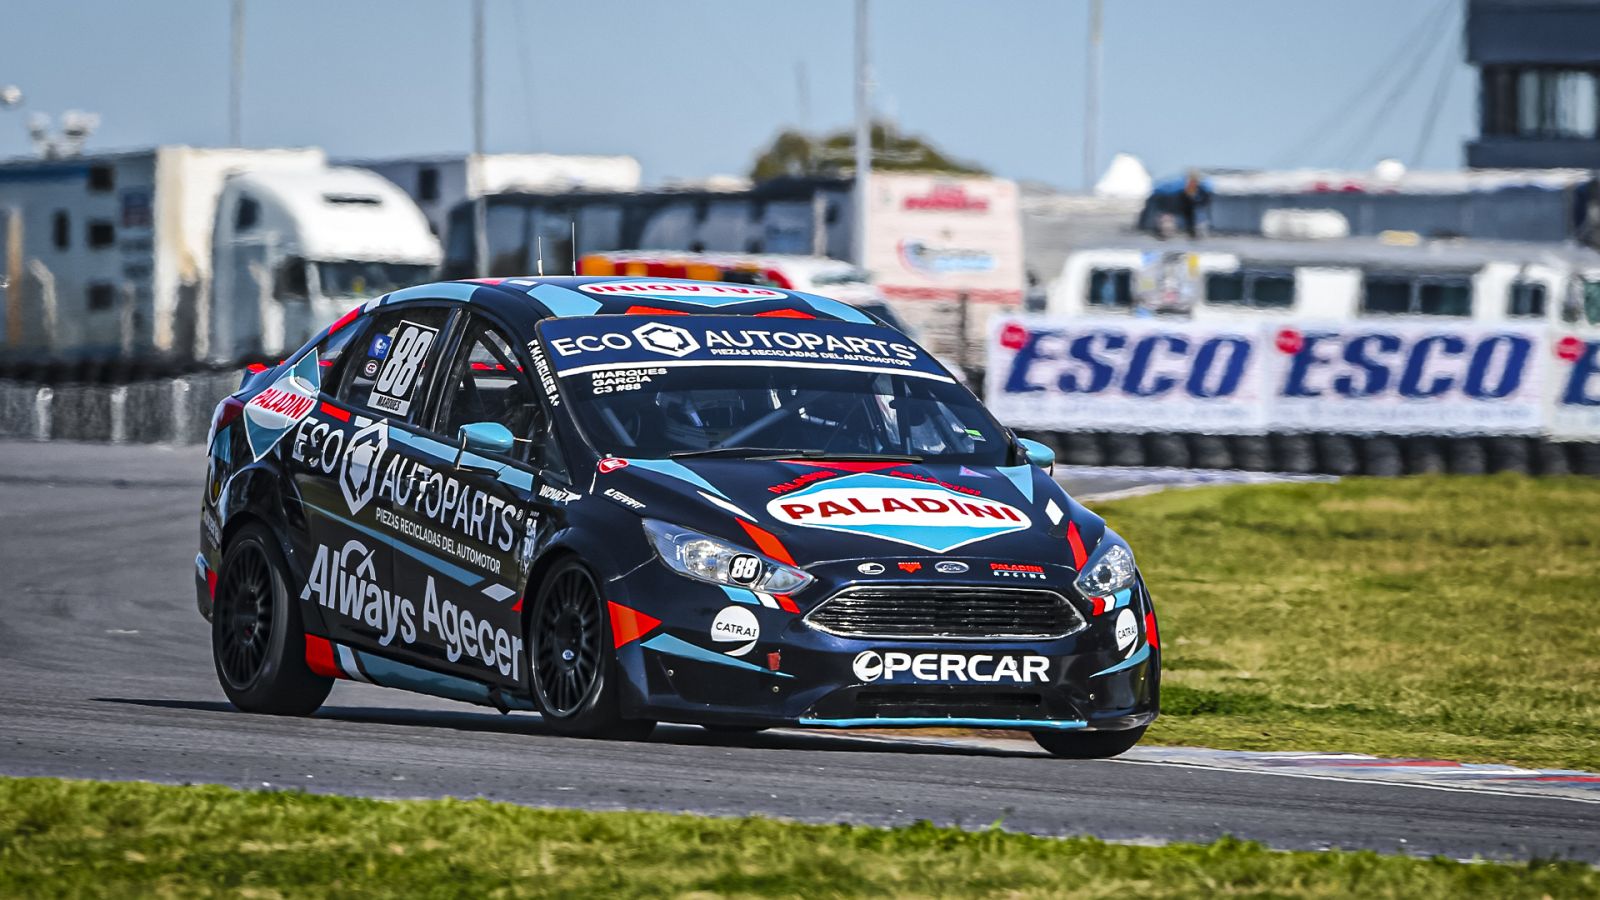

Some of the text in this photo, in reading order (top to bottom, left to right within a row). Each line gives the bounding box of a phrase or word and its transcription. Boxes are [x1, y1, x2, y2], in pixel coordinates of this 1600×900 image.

[550, 332, 633, 357] ECO
[377, 326, 433, 397] 88
[711, 348, 912, 367] PIEZAS RECICLADAS DEL AUTOMOTOR
[1004, 328, 1251, 397] ESCO
[1281, 333, 1532, 398] ESCO
[592, 367, 668, 380] MARQUES
[593, 383, 642, 395] C3 #88
[254, 388, 314, 420] PALADINI
[780, 497, 1021, 523] PALADINI
[376, 506, 400, 530] PIEZAS
[400, 517, 441, 549] RECICLADAS
[442, 535, 456, 555] DEL
[456, 542, 501, 574] AUTOMOTOR
[731, 554, 758, 578] 88
[990, 563, 1044, 573] PALADINI
[993, 571, 1047, 580] RACING
[300, 543, 523, 682] Always Agecer
[715, 621, 757, 638] CATRAI
[884, 652, 1050, 683] PERCAR
